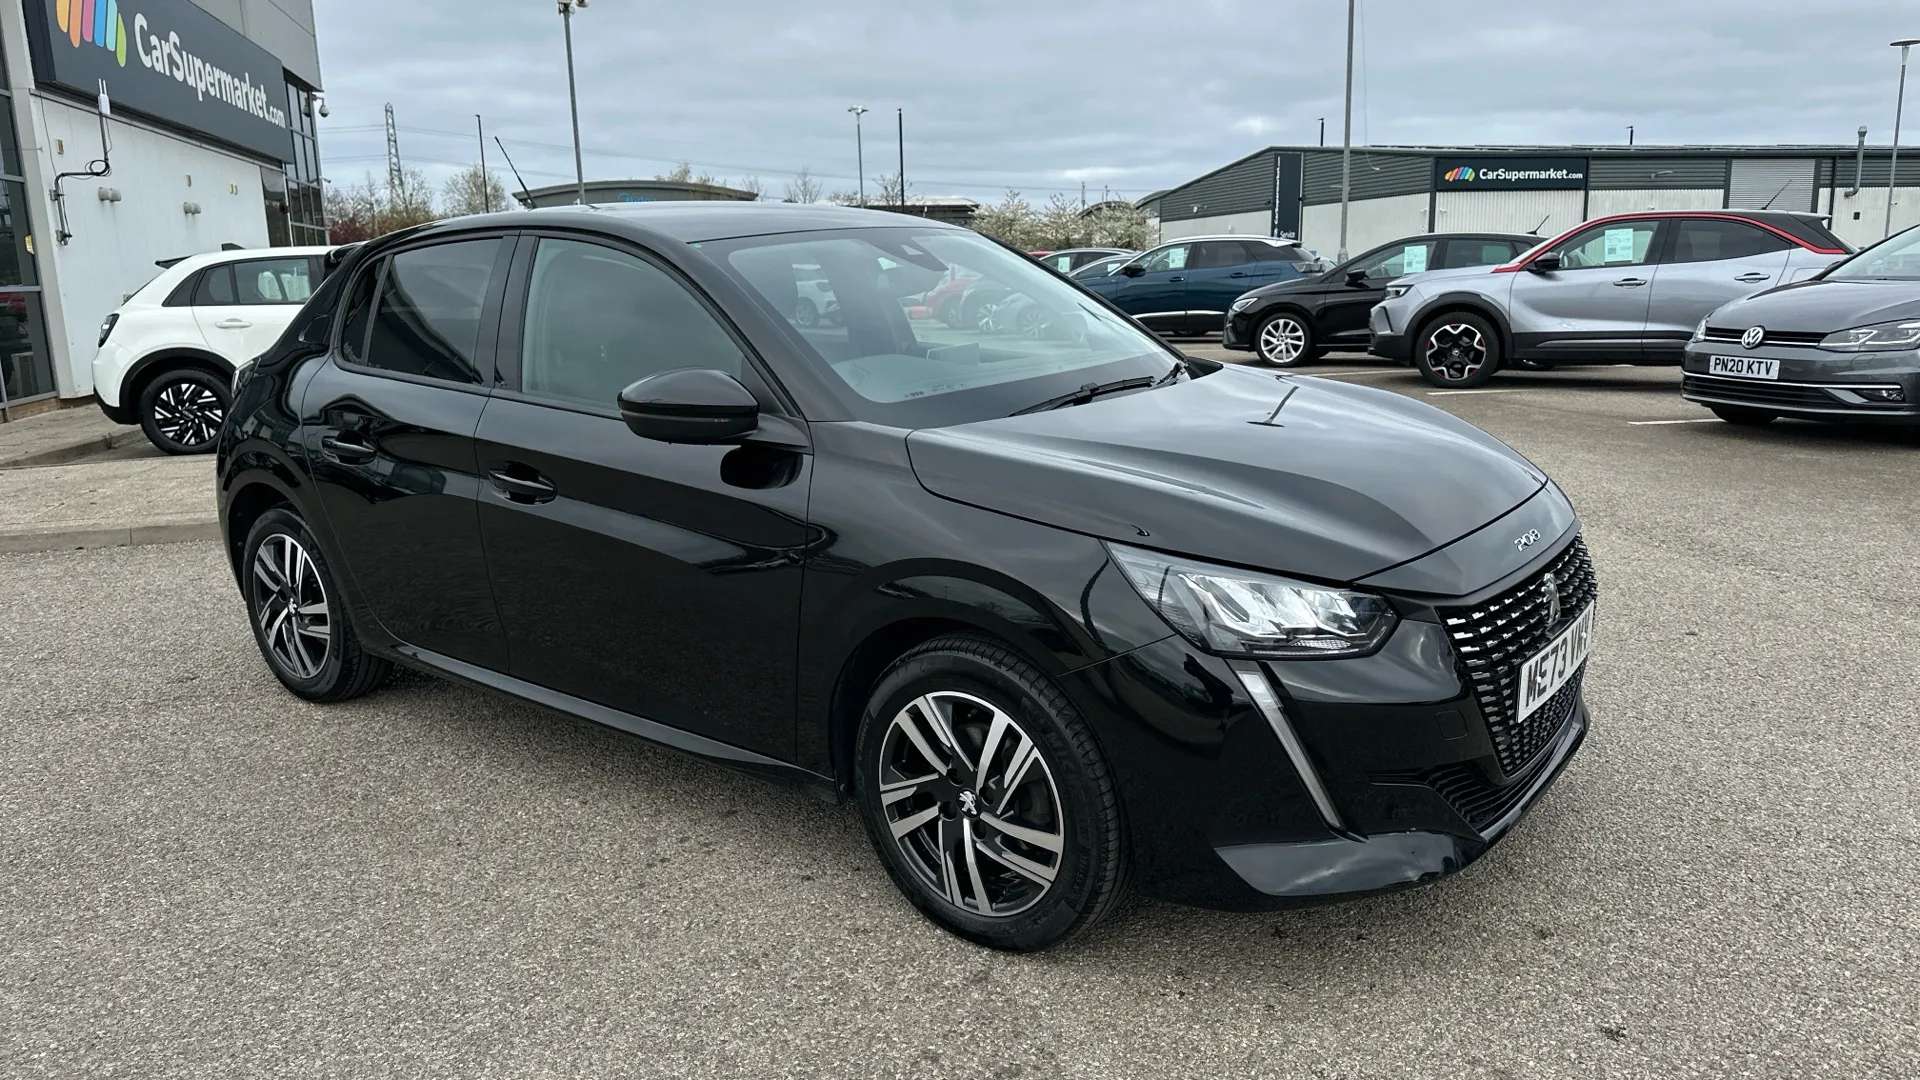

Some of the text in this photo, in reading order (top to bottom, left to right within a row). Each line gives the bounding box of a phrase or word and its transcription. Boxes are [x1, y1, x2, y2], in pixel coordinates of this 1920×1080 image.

[134, 13, 286, 129] CarSupermarket.com
[1479, 168, 1583, 181] CarSupermarket.com
[1713, 357, 1773, 375] PN20 KTV
[1513, 528, 1540, 551] 208
[1526, 636, 1568, 707] ME73
